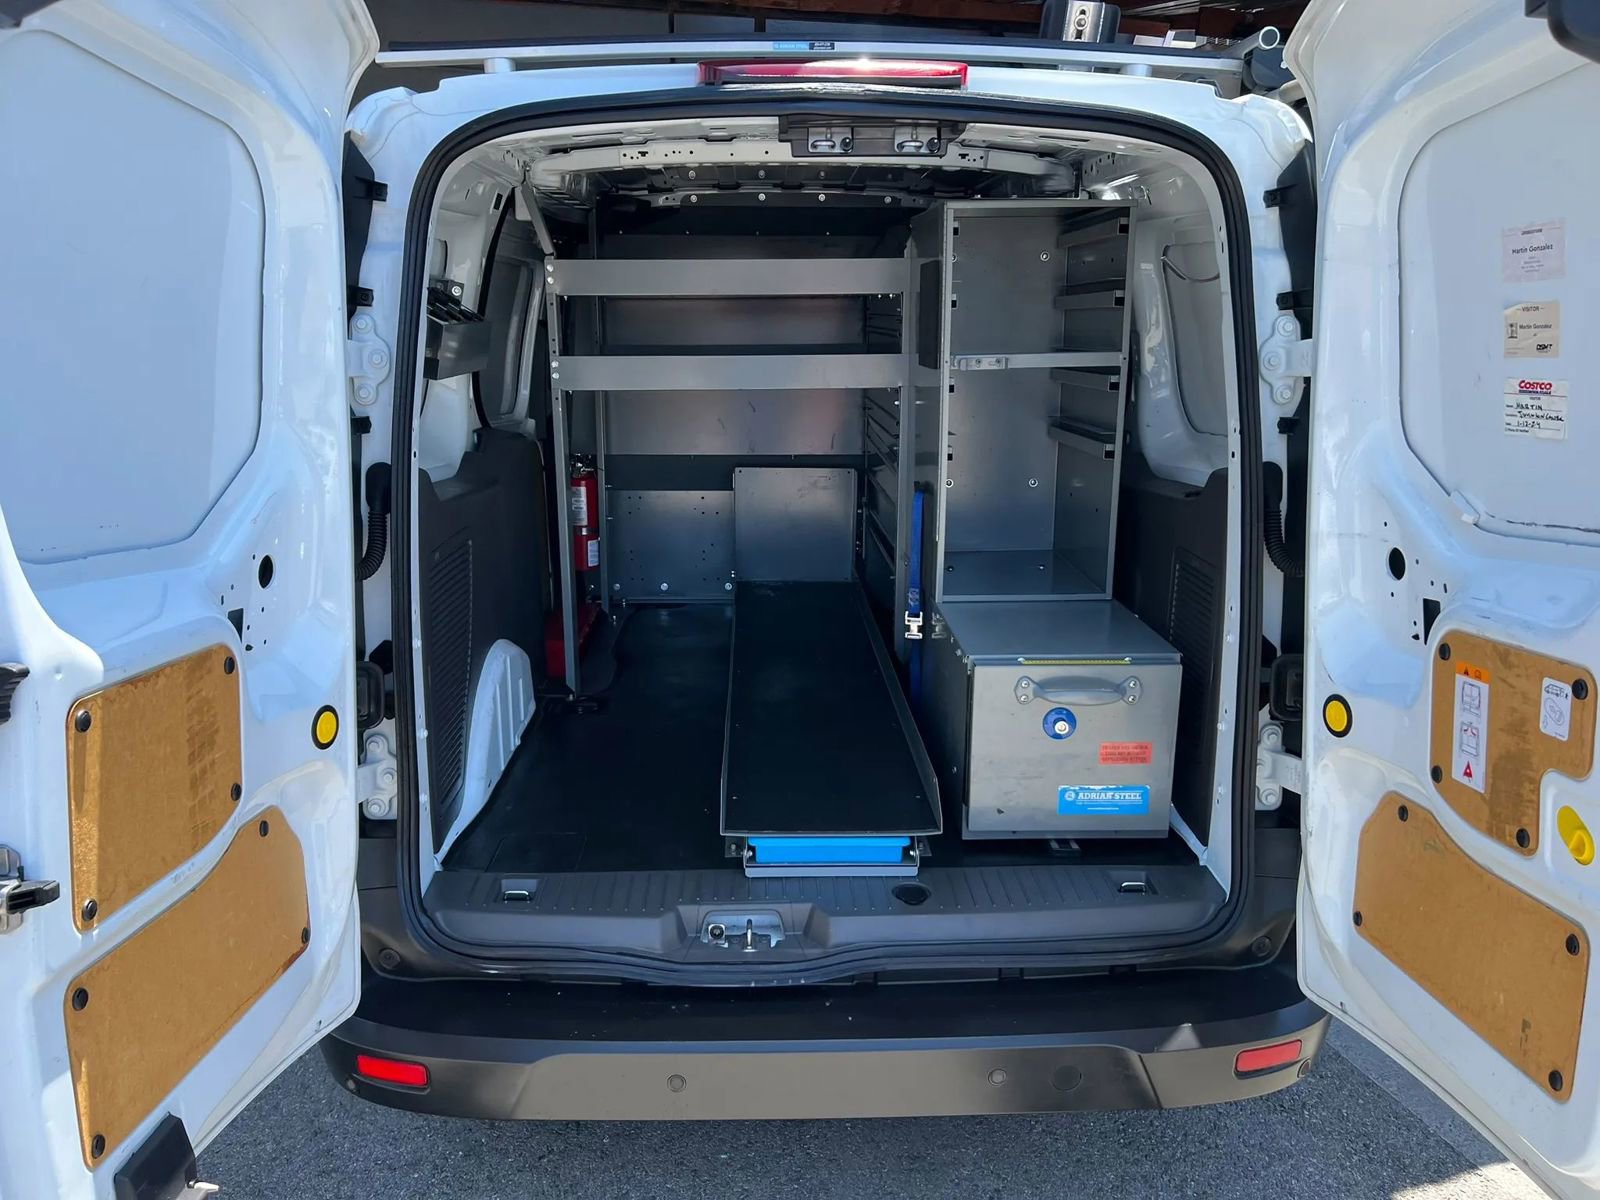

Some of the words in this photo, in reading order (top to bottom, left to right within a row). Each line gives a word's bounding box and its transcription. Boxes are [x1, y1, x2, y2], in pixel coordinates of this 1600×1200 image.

[1511, 246, 1528, 255] Martin
[1529, 243, 1553, 252] Gonzalez
[1519, 380, 1552, 390] COSTCO
[1515, 402, 1543, 411] MARTIN
[1078, 792, 1113, 800] ADRIAN
[1114, 792, 1141, 800] STEEL
